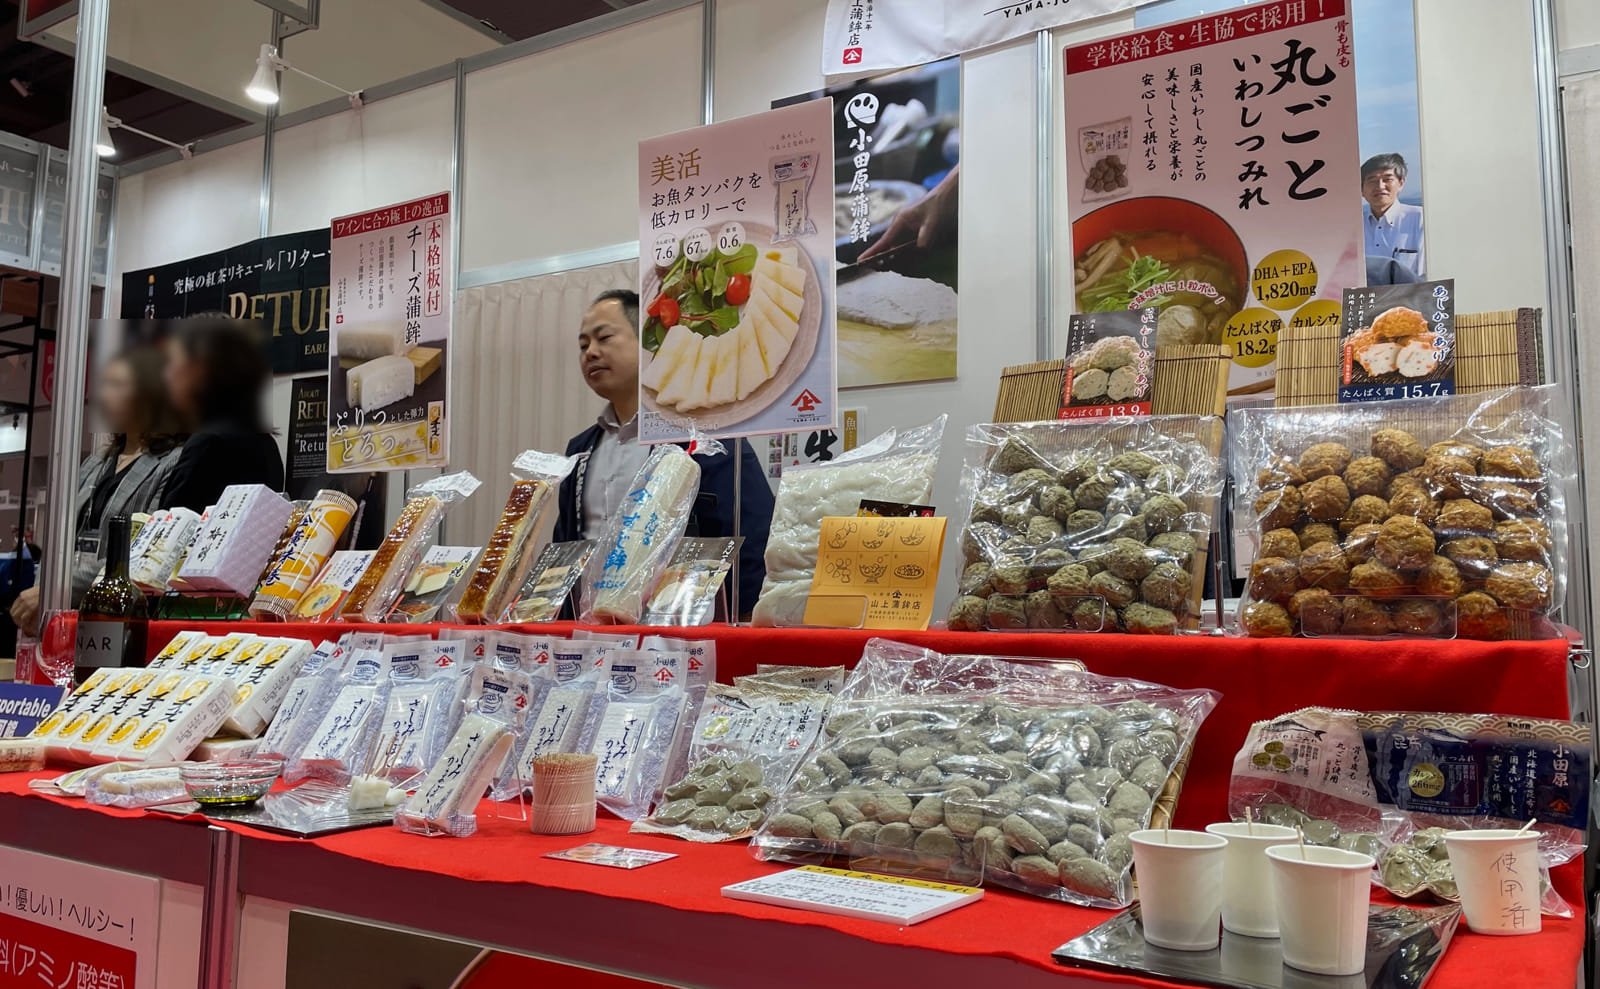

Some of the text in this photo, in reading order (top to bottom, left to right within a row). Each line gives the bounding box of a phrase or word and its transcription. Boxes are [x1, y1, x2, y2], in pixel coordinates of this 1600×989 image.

[1087, 0, 1325, 67] 学校給食・生協で採用！
[1334, 20, 1351, 68] 骨も皮も
[1141, 73, 1158, 171] 安心して摂れる
[1165, 67, 1183, 181] 美味しさと栄養が
[1190, 63, 1207, 181] 国産いわし丸ごとの
[1233, 54, 1269, 210] いわしつみれ
[1267, 39, 1336, 200] 丸ごと
[651, 148, 702, 186] 美活
[651, 172, 763, 208] お魚タンパクを
[848, 128, 872, 243] 小田原蒲鉾
[336, 197, 444, 236] ワインに合う極上の逸品
[651, 197, 747, 231] 低カロリーで
[174, 247, 331, 296] 究極の紅茶リキュール「リター
[405, 225, 421, 344] チーズ蒲鉾
[427, 221, 441, 313] 本格板付
[1254, 261, 1317, 281] DHA+EPA
[1256, 280, 1317, 301] 1,820mg
[1226, 318, 1282, 338] たんぱく質
[1236, 338, 1276, 357] 18.2g
[1432, 285, 1449, 362] あじからあげ
[1342, 387, 1395, 399] たんぱく質
[1401, 383, 1449, 400] 15.7g
[1552, 745, 1569, 787] 小田原
[0, 884, 135, 942] ！優しい！ヘルシー！
